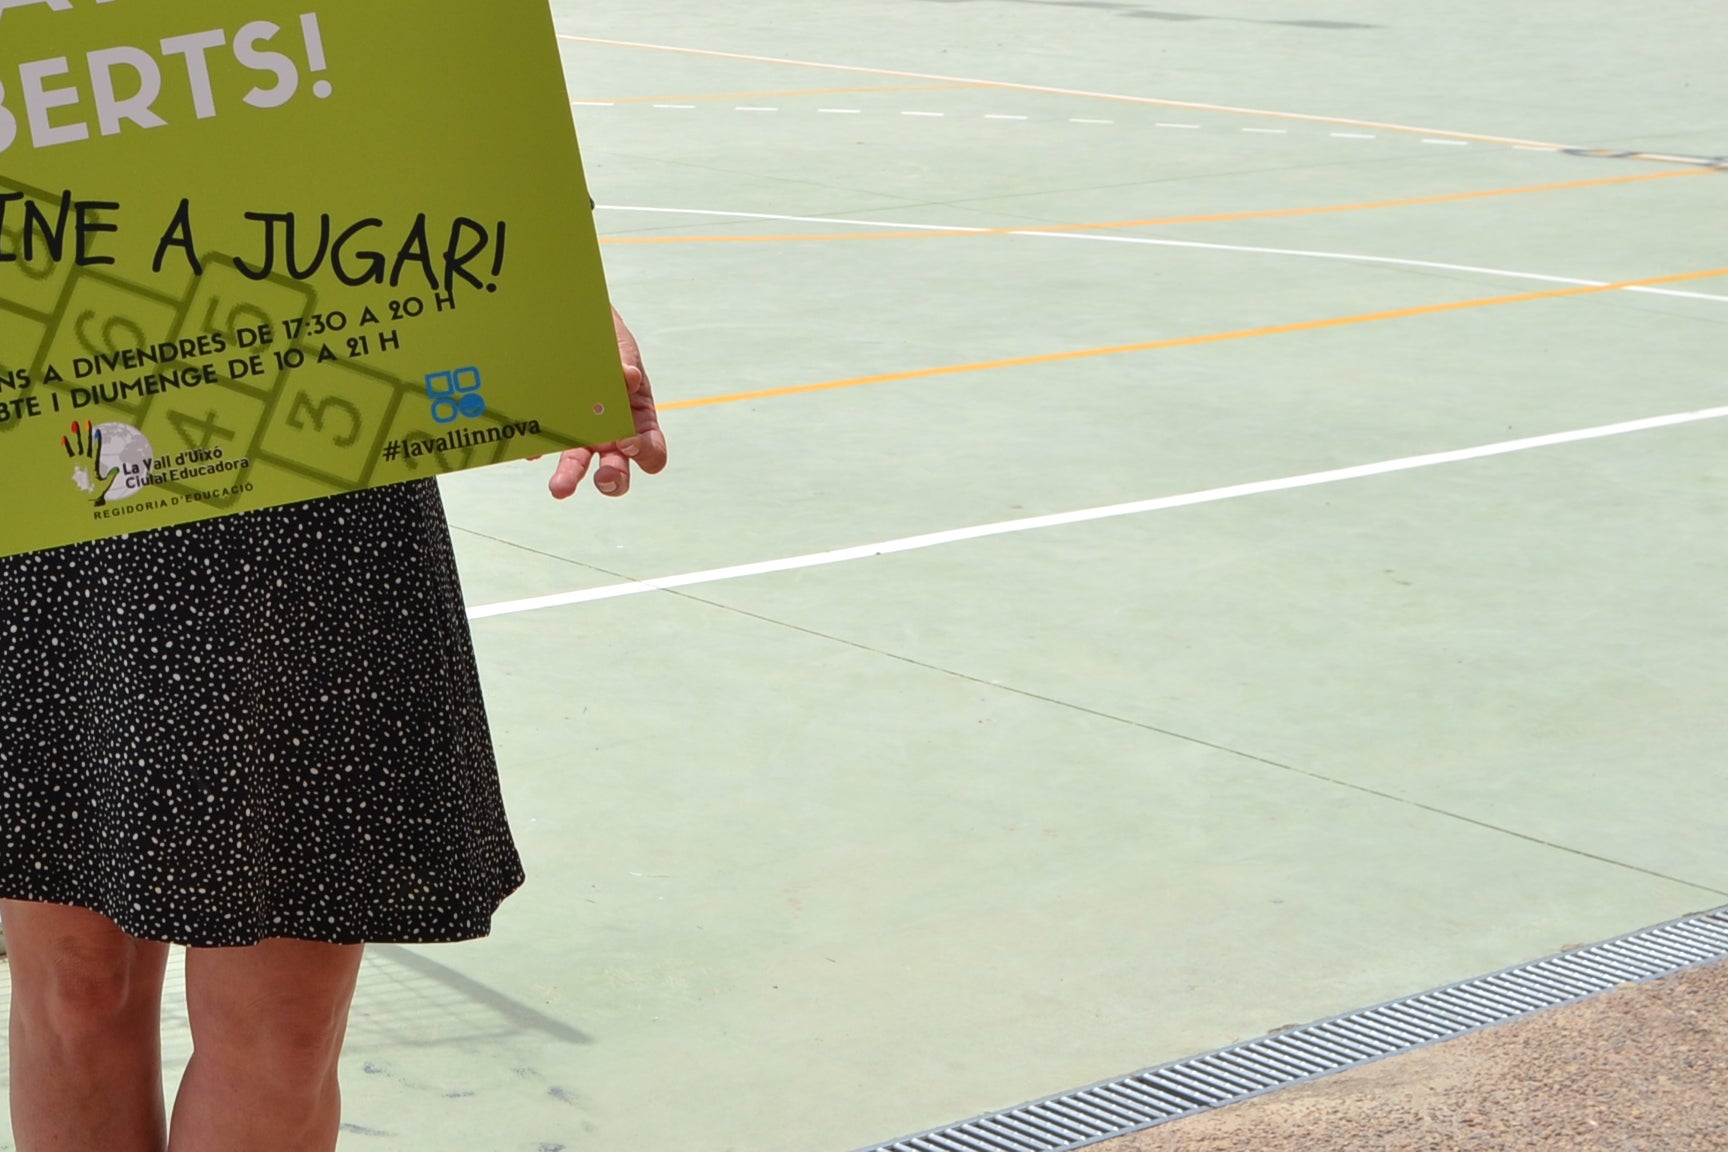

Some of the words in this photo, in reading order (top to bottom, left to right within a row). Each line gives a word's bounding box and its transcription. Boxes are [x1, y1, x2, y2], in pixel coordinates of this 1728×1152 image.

[152, 198, 202, 276] A
[233, 212, 506, 292] JUGAR!
[42, 364, 64, 385] A
[72, 332, 227, 379] DIVENDRES
[237, 324, 273, 348] DE
[282, 311, 348, 340] 17:30
[359, 305, 380, 327] A
[388, 296, 424, 320] 20
[435, 291, 456, 312] H
[52, 392, 60, 412] I
[71, 365, 219, 409] DIUMENGE
[228, 355, 265, 380] DE
[274, 348, 305, 371] 10
[317, 343, 338, 364] A
[346, 336, 369, 359] 21
[379, 330, 400, 352] H
[122, 462, 140, 476] La
[142, 454, 171, 472] Vall
[175, 445, 223, 466] d'Uixó
[382, 419, 542, 462] #lavallinnova
[171, 457, 250, 481] Educadora
[93, 500, 168, 520] REGIDORIA
[171, 483, 254, 506] D'EDUCACIÓ
